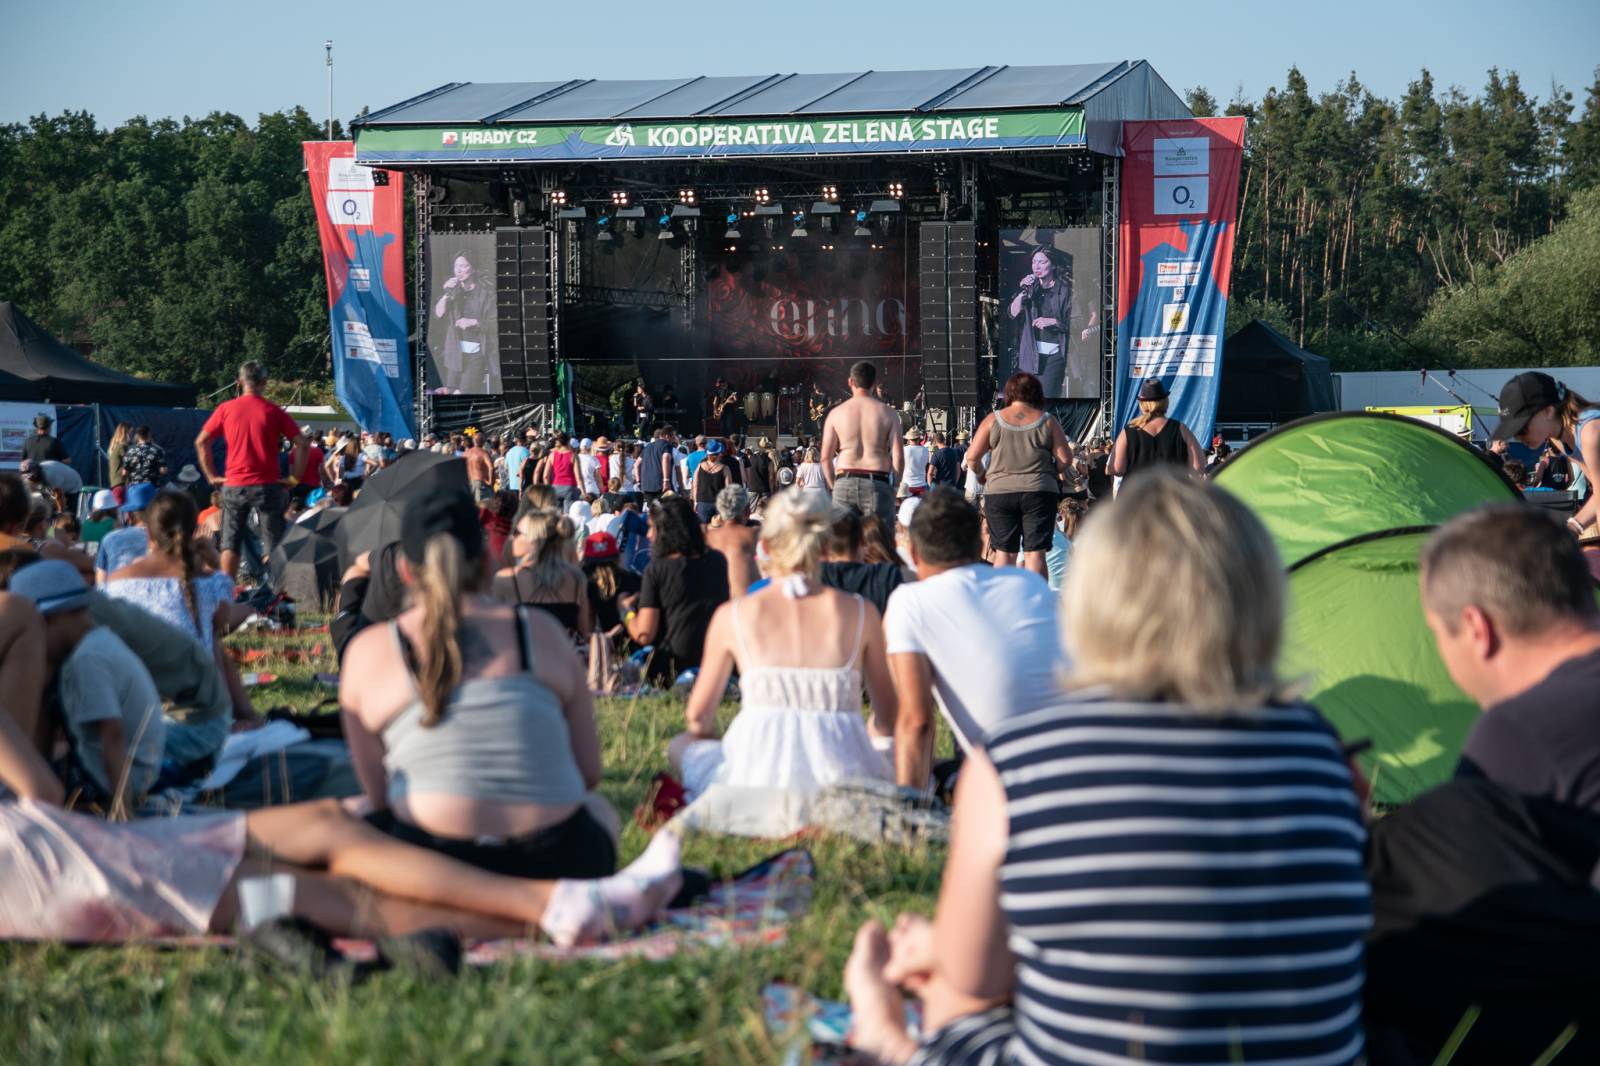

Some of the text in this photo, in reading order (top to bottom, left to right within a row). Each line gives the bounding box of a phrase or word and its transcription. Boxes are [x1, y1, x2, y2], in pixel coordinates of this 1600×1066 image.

[462, 131, 537, 145] HRADY CZ
[648, 117, 999, 147] KOOPERATIVA ZELENÁ STAGE
